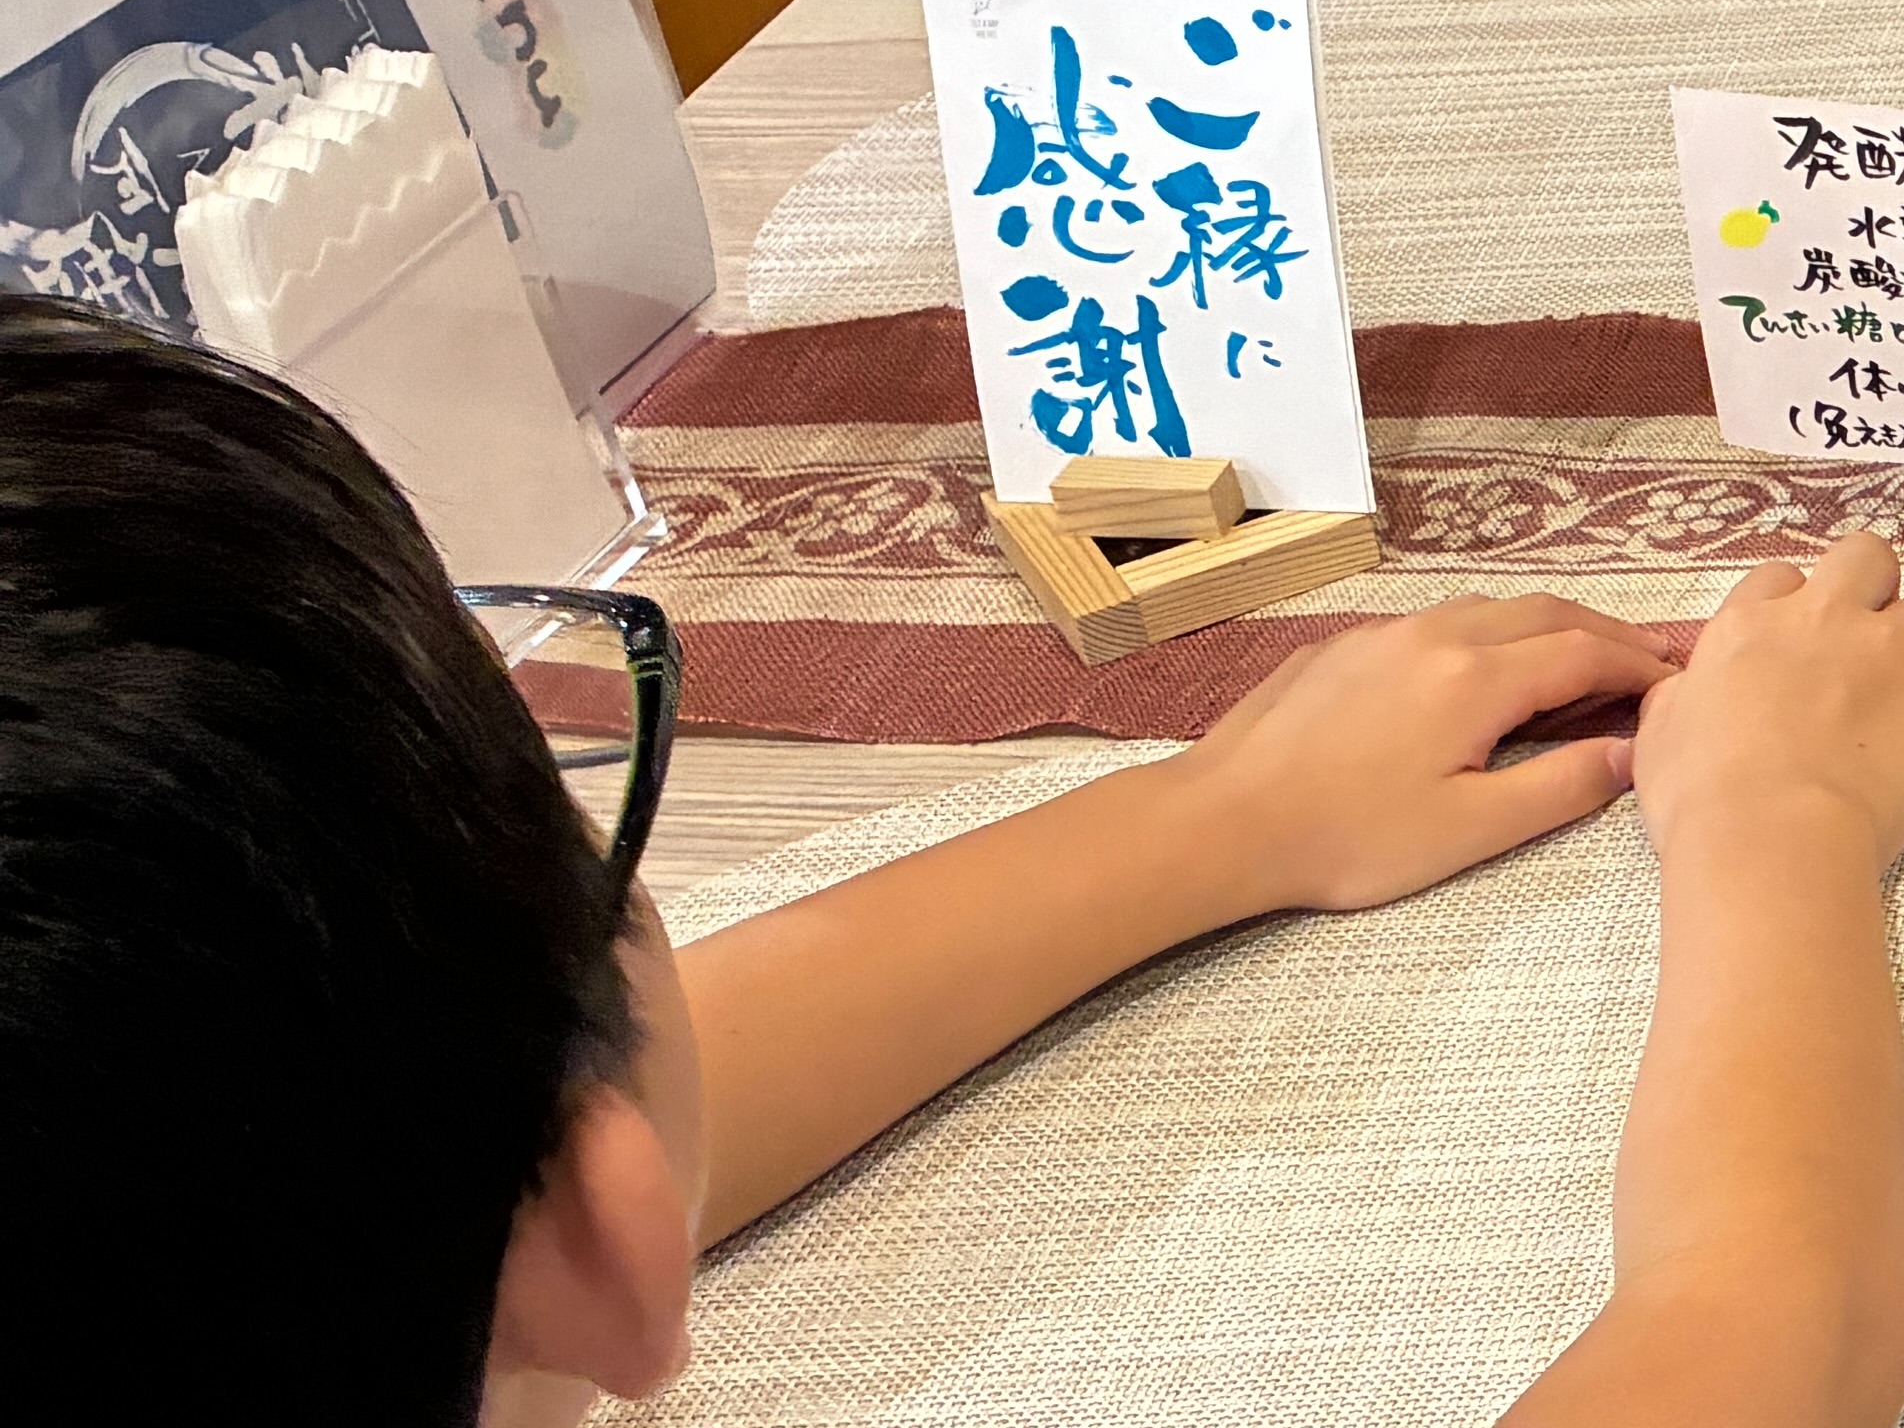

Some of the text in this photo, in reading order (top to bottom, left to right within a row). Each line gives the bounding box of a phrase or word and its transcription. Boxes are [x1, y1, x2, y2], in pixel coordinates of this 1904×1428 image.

[973, 25, 1193, 458] 感謝
[1148, 8, 1309, 379] ご縁に
